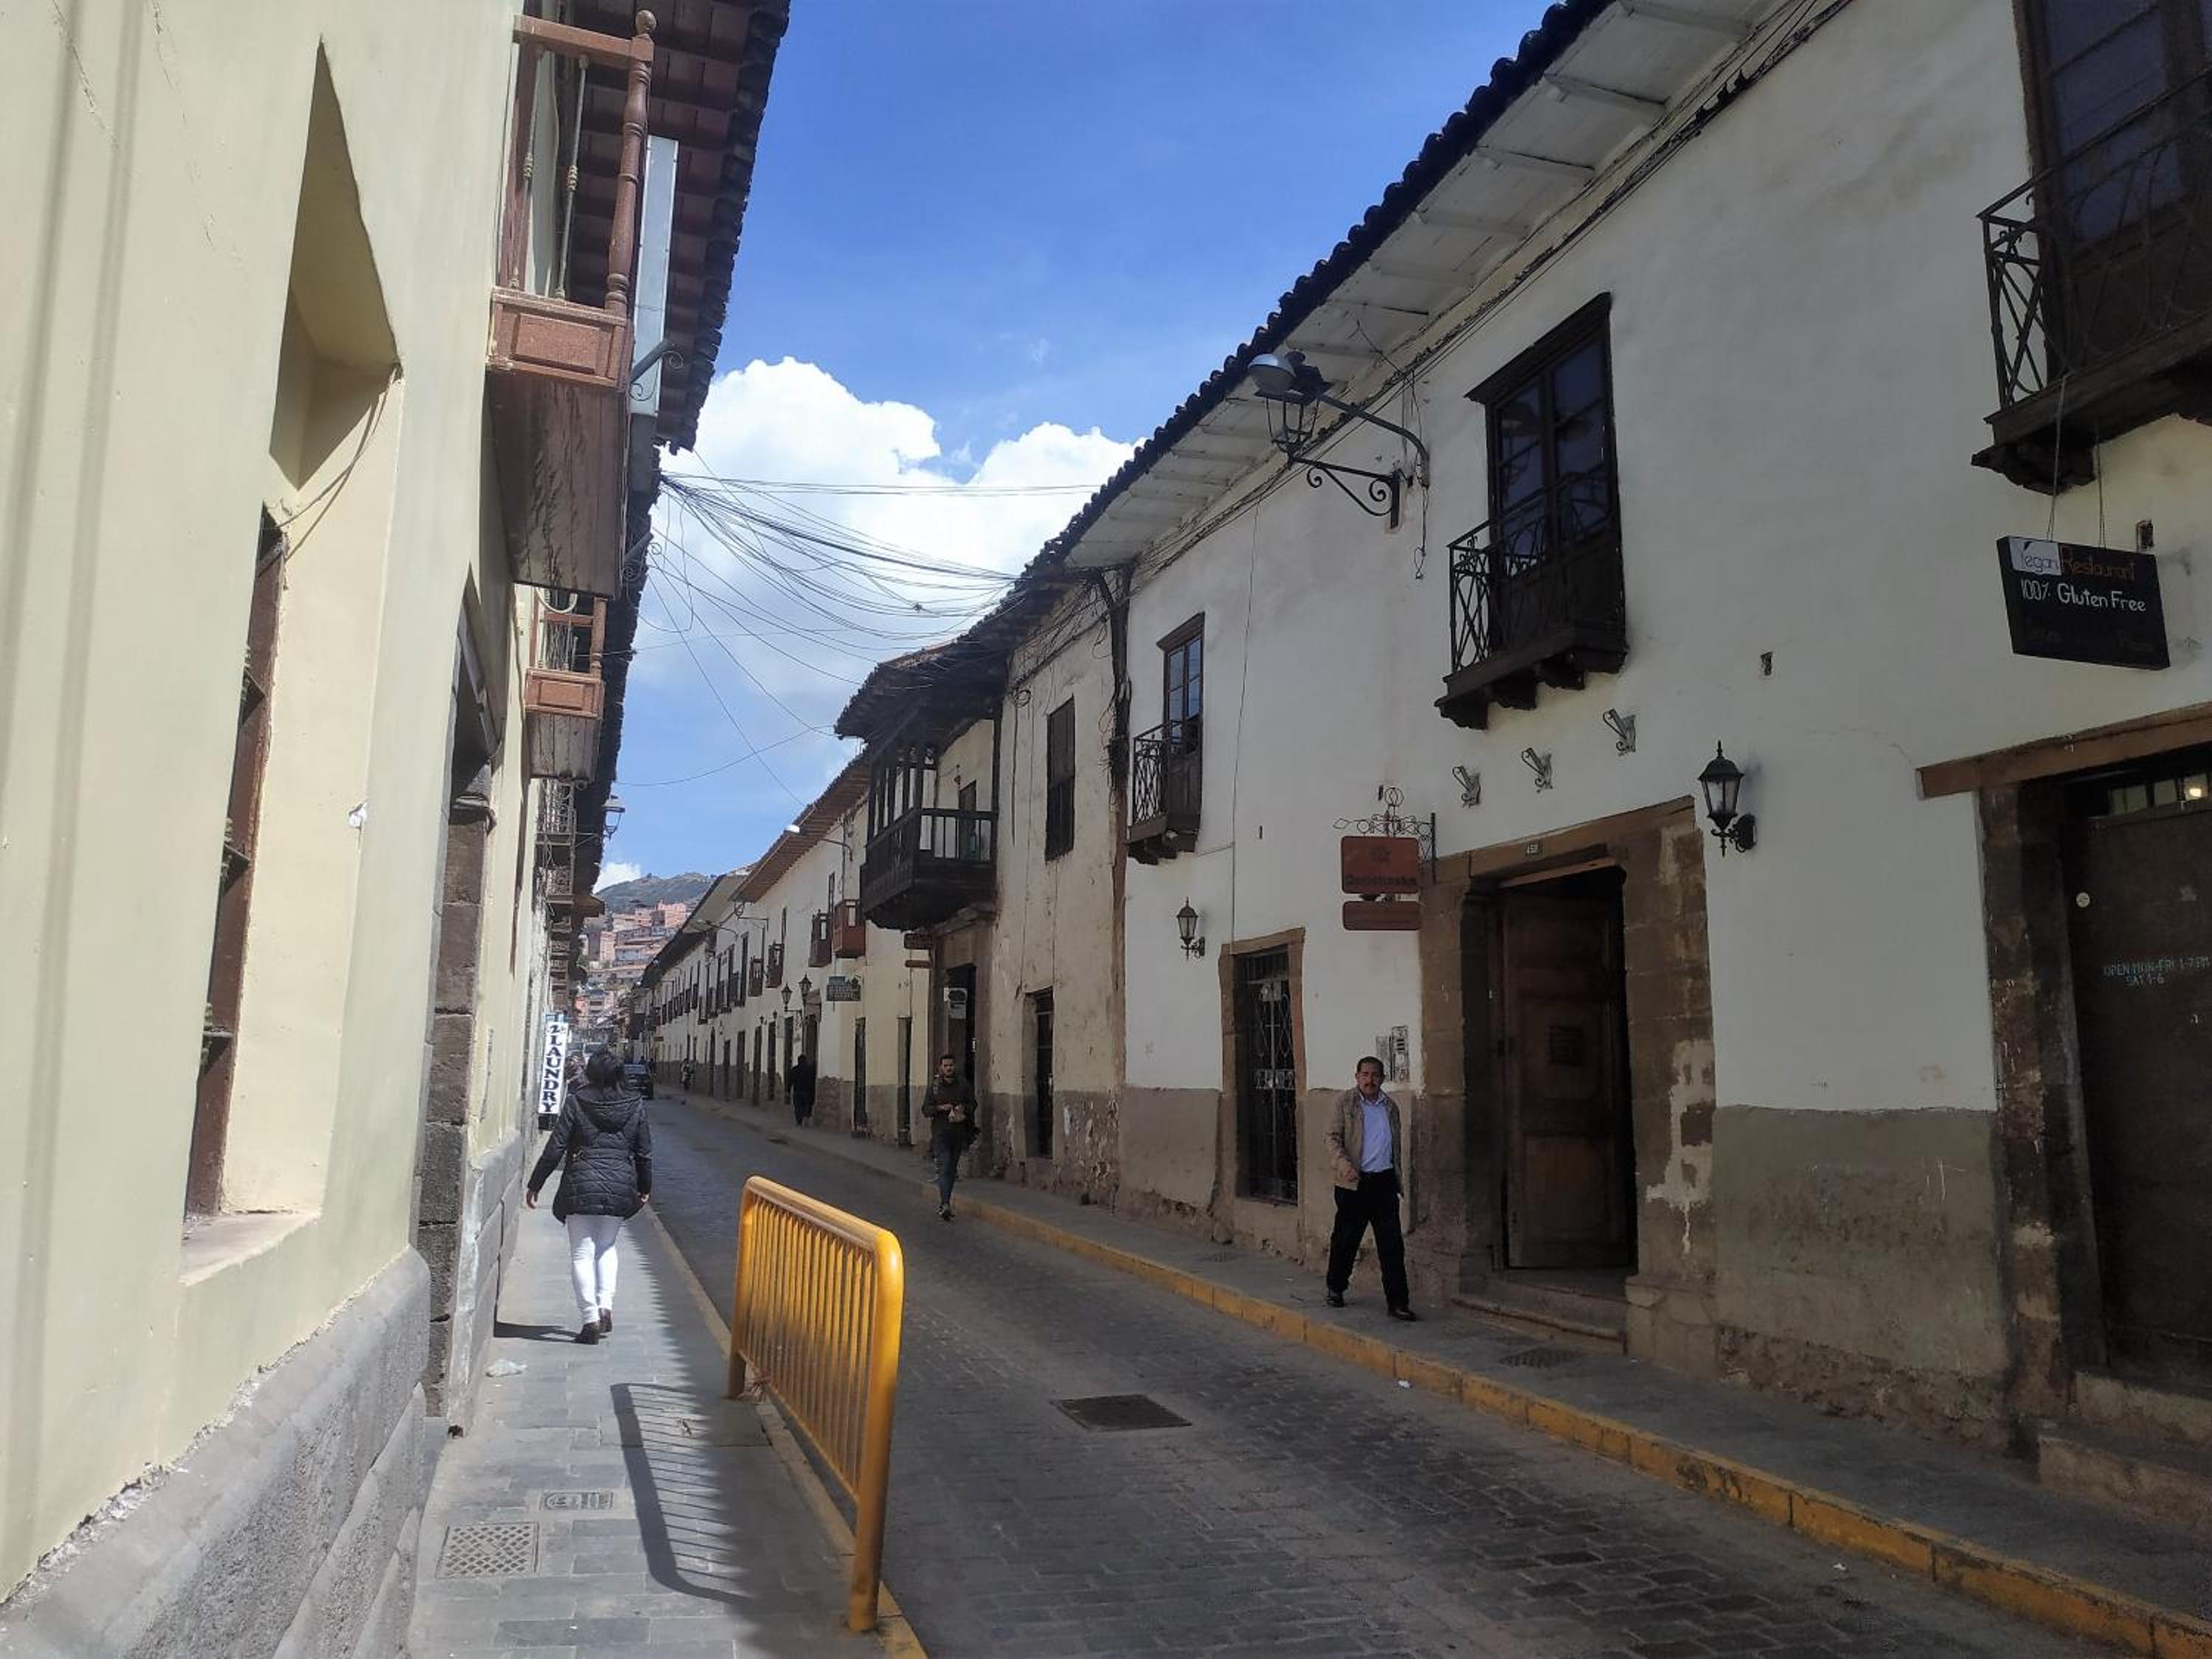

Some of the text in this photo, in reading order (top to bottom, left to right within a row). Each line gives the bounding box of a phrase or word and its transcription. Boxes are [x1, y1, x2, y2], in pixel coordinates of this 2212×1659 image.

[2057, 582, 2107, 608] Gluten
[2110, 590, 2147, 612] Free
[543, 1035, 563, 1113] LAUNDRY
